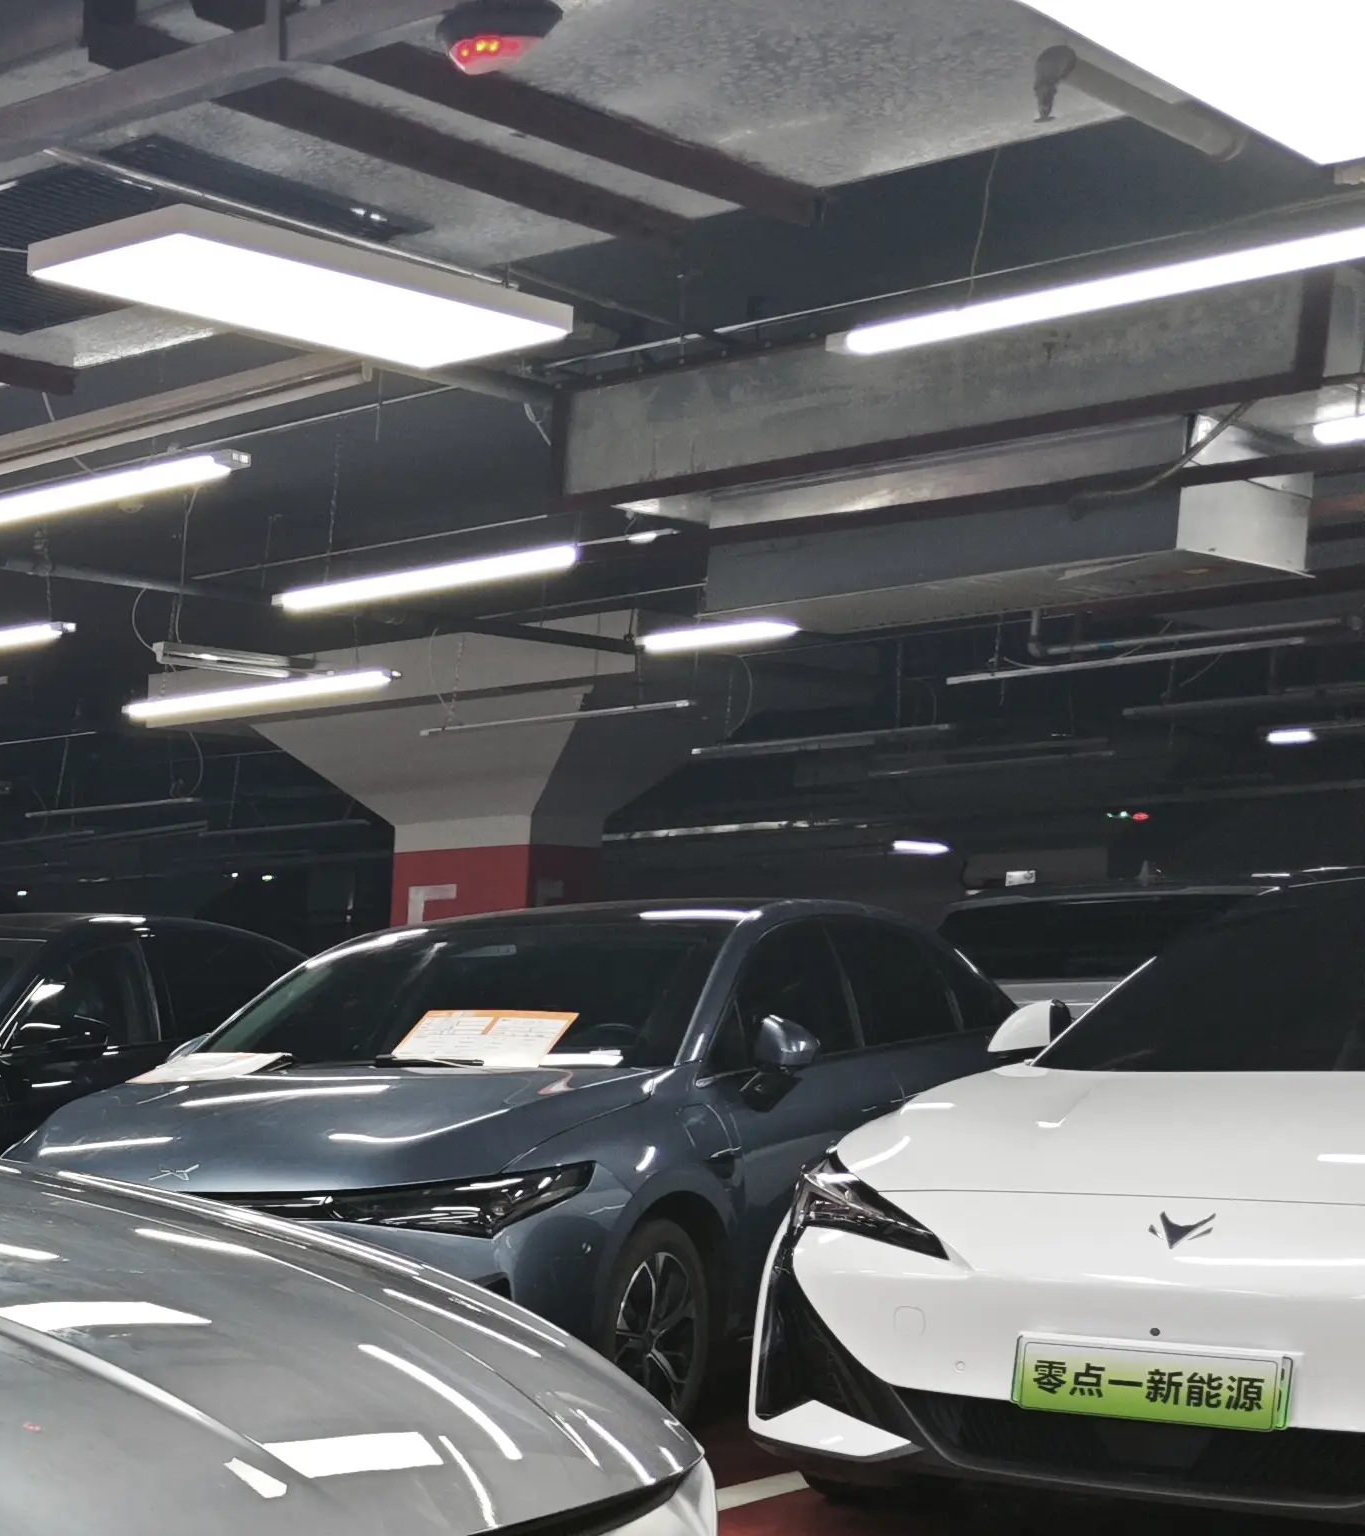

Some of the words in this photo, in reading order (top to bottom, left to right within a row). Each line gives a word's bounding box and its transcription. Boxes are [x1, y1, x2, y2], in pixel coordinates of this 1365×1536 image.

[1032, 1358, 1266, 1413] 零点一新能源
